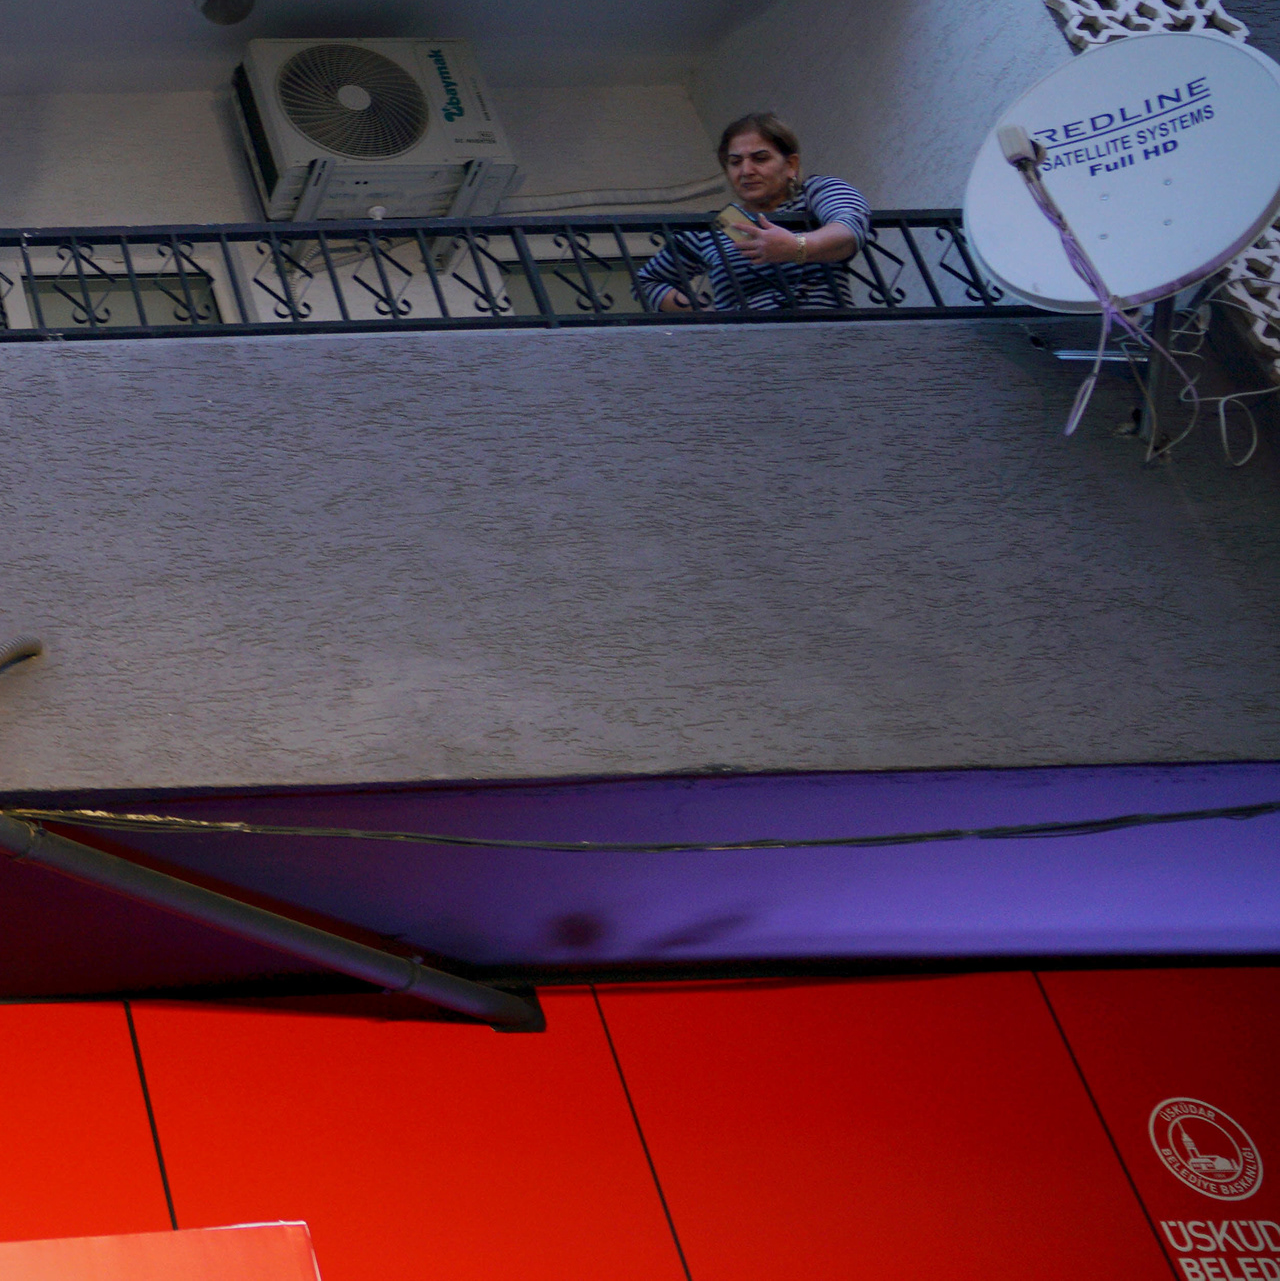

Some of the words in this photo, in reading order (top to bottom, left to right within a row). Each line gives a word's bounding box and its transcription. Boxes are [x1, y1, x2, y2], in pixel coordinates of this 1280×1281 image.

[1033, 76, 1211, 143] REDLINE
[1041, 135, 1133, 172] SATELLITE
[1137, 104, 1215, 145] SYSTEMS
[1089, 154, 1136, 177] Full
[1143, 139, 1179, 161] HD
[1159, 1102, 1216, 1123] ÜSKÜDAR
[1178, 1257, 1280, 1281] BELED
